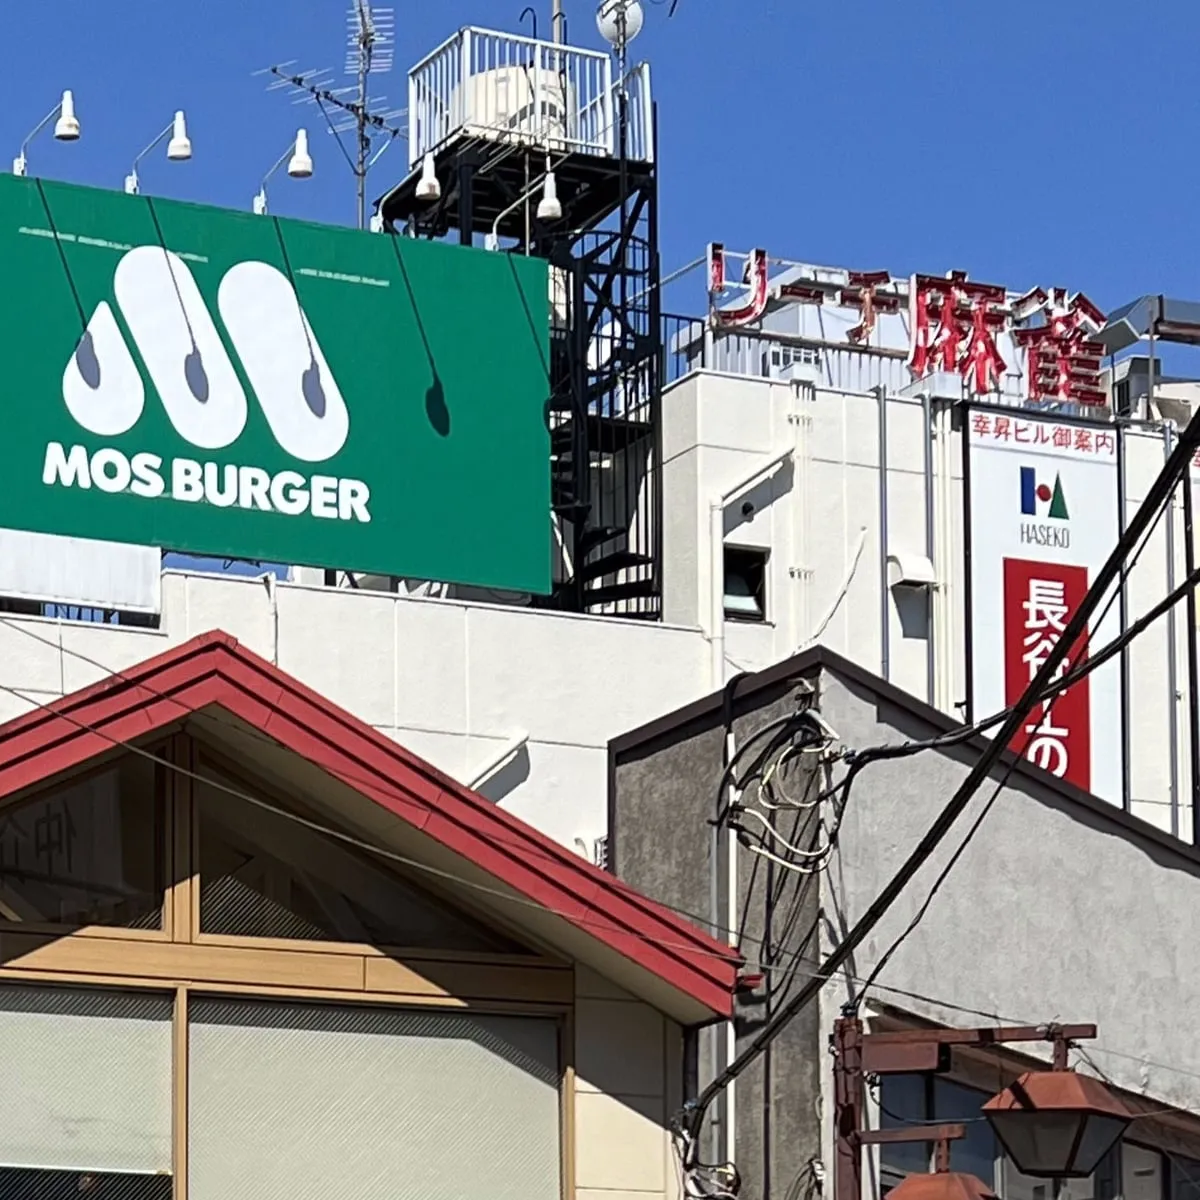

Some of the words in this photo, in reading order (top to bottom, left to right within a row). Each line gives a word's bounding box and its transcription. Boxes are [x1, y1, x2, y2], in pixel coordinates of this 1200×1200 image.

[707, 242, 1108, 408] リーチ麻雀
[972, 413, 1115, 455] 幸昇ビル御案内
[42, 442, 165, 498] MOS
[171, 457, 372, 523] BURGER
[1020, 521, 1070, 550] HASEKO
